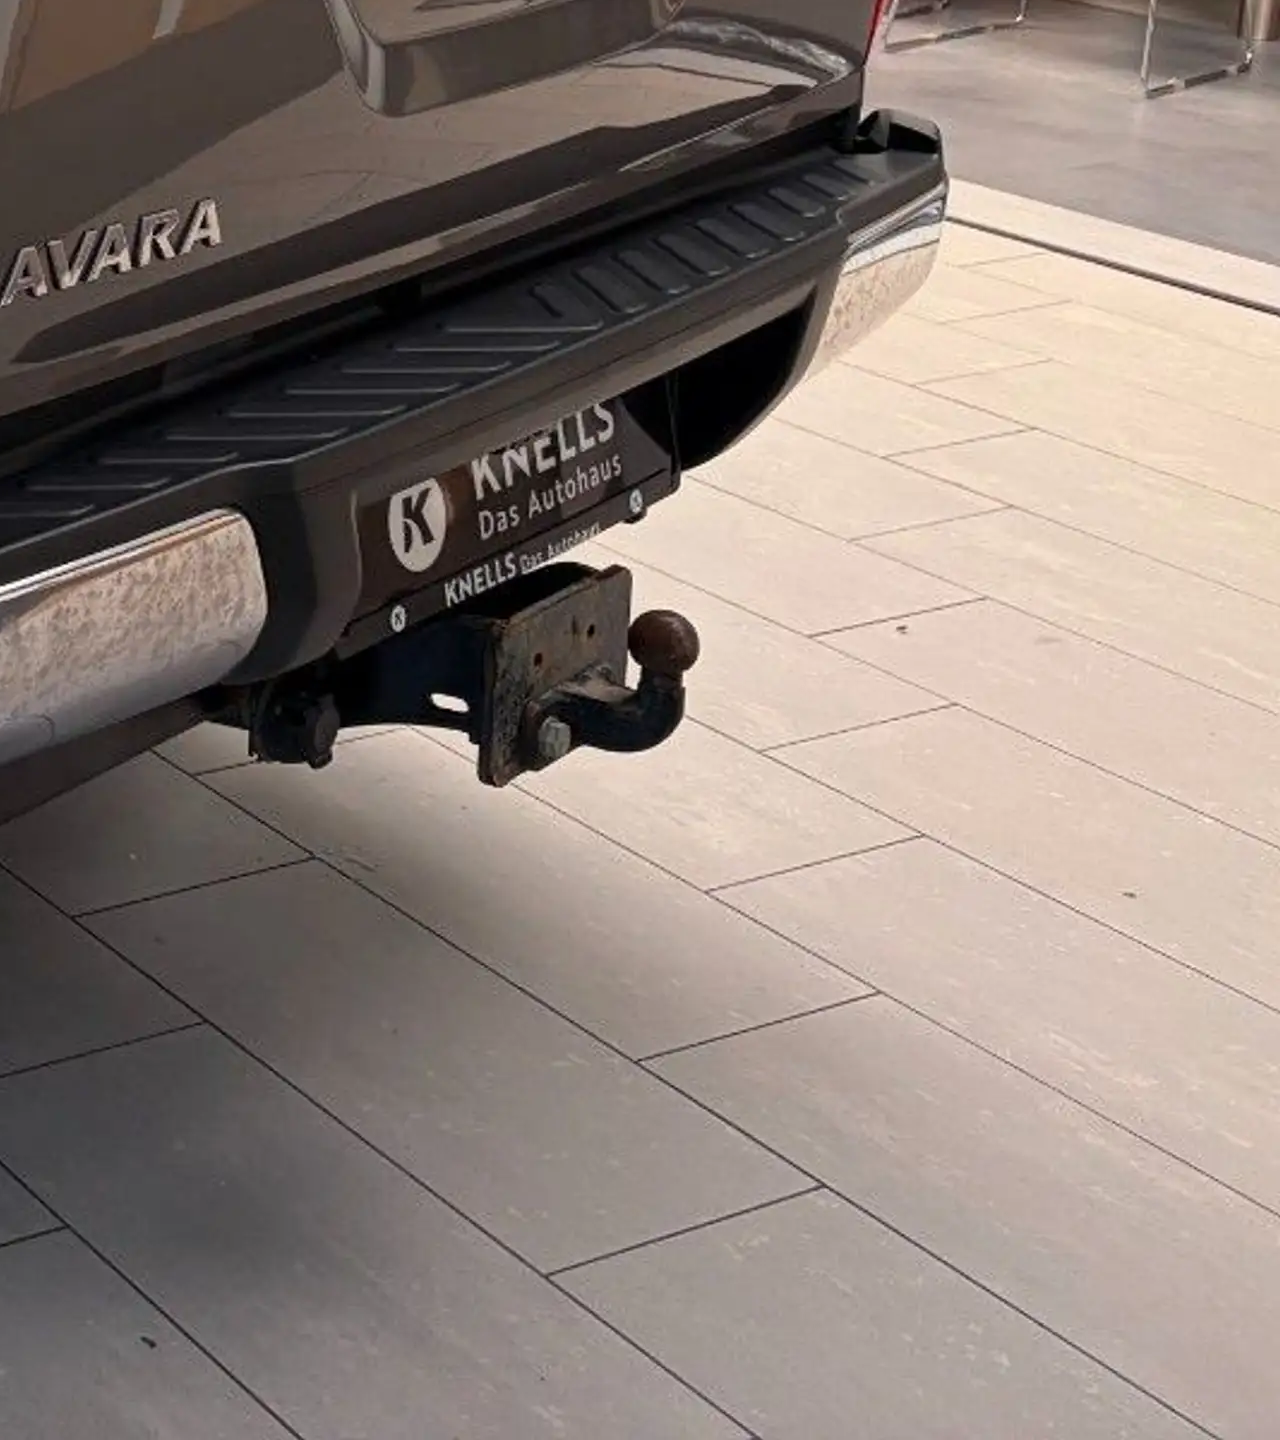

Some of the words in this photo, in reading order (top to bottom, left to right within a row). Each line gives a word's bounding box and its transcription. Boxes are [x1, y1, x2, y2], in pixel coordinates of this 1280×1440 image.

[470, 400, 617, 501] KNELLS
[478, 502, 521, 542] Das
[527, 454, 623, 521] Autohaus
[443, 550, 517, 609] KNELLS
